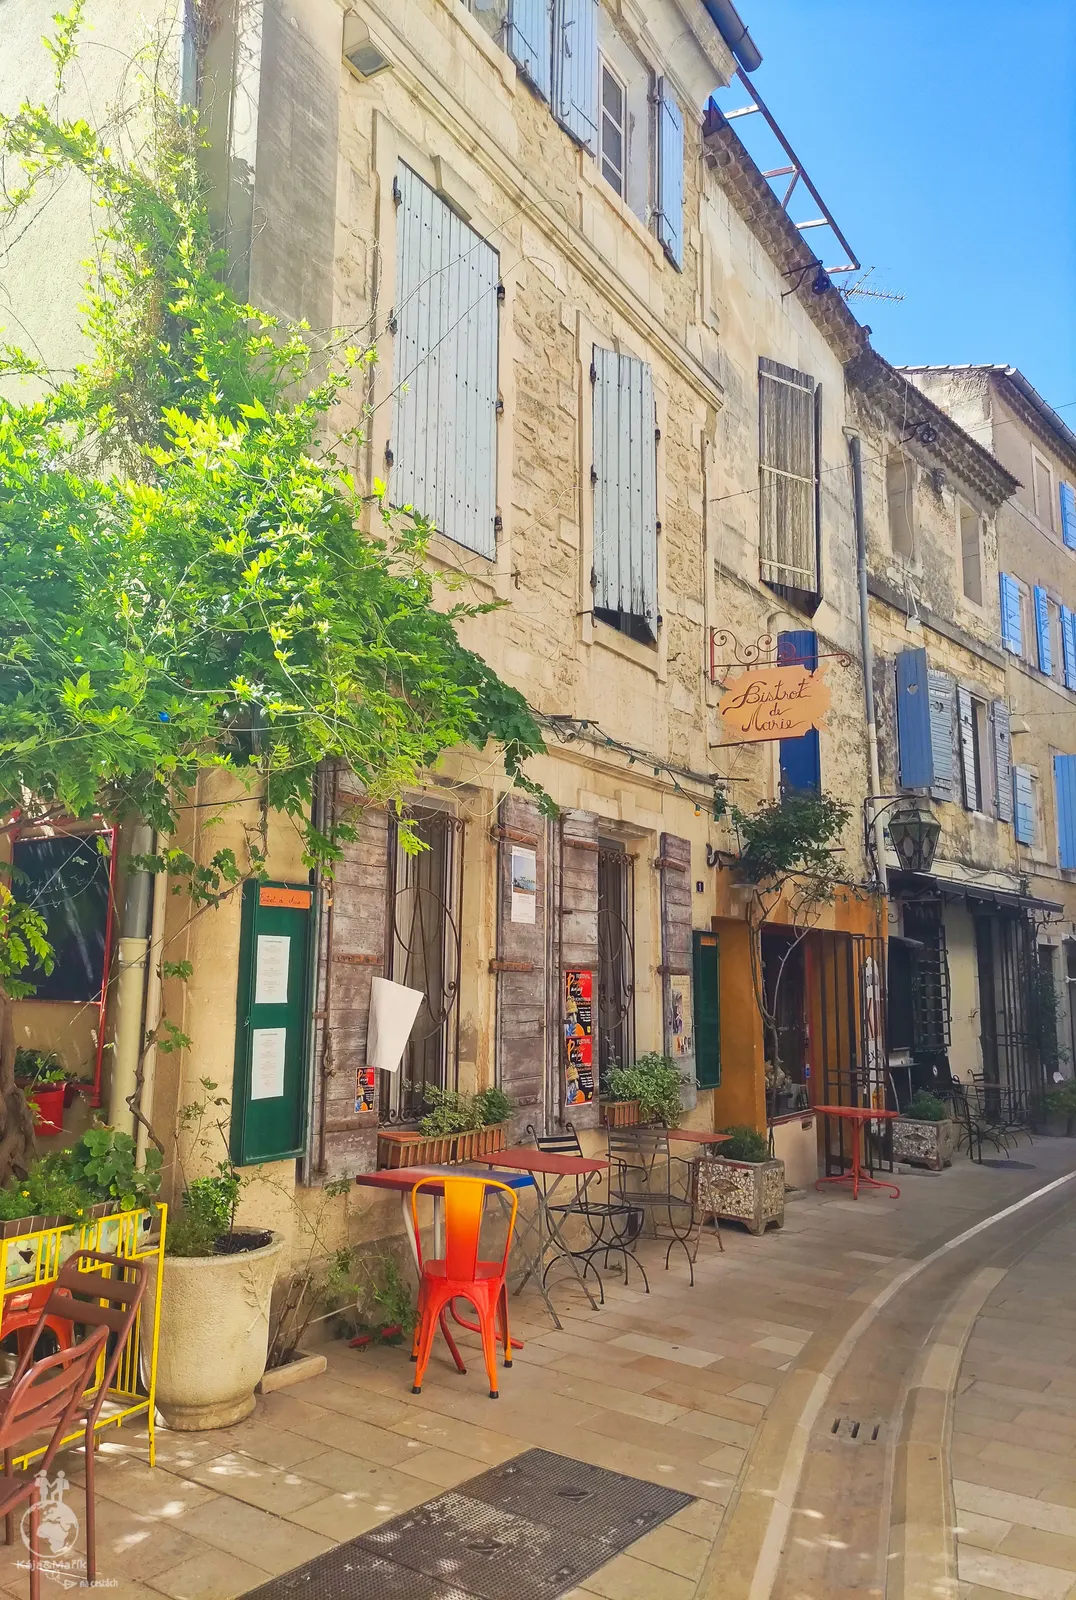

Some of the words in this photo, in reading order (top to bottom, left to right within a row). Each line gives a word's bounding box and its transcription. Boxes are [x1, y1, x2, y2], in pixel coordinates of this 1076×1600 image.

[722, 678, 811, 715] Bistrot
[769, 702, 793, 716] de
[742, 703, 805, 732] Marie
